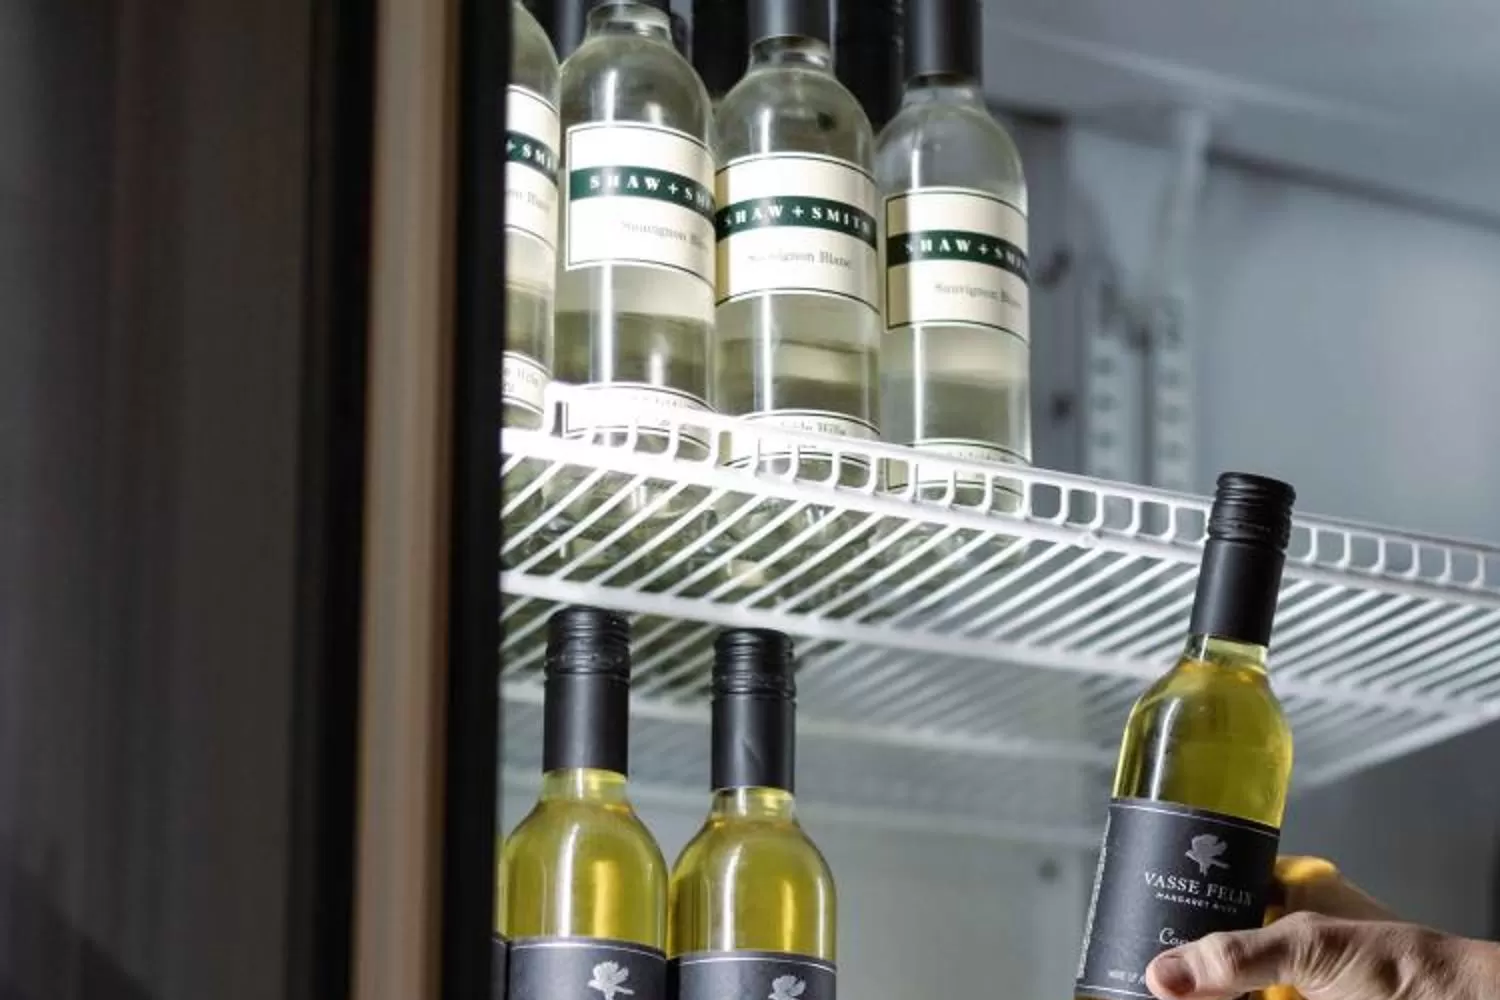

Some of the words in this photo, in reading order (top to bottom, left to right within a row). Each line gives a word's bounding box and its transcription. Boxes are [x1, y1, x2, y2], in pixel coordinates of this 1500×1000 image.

[590, 174, 661, 191] SHAW
[1143, 870, 1201, 895] VASSE
[1206, 882, 1252, 907] FELIX
